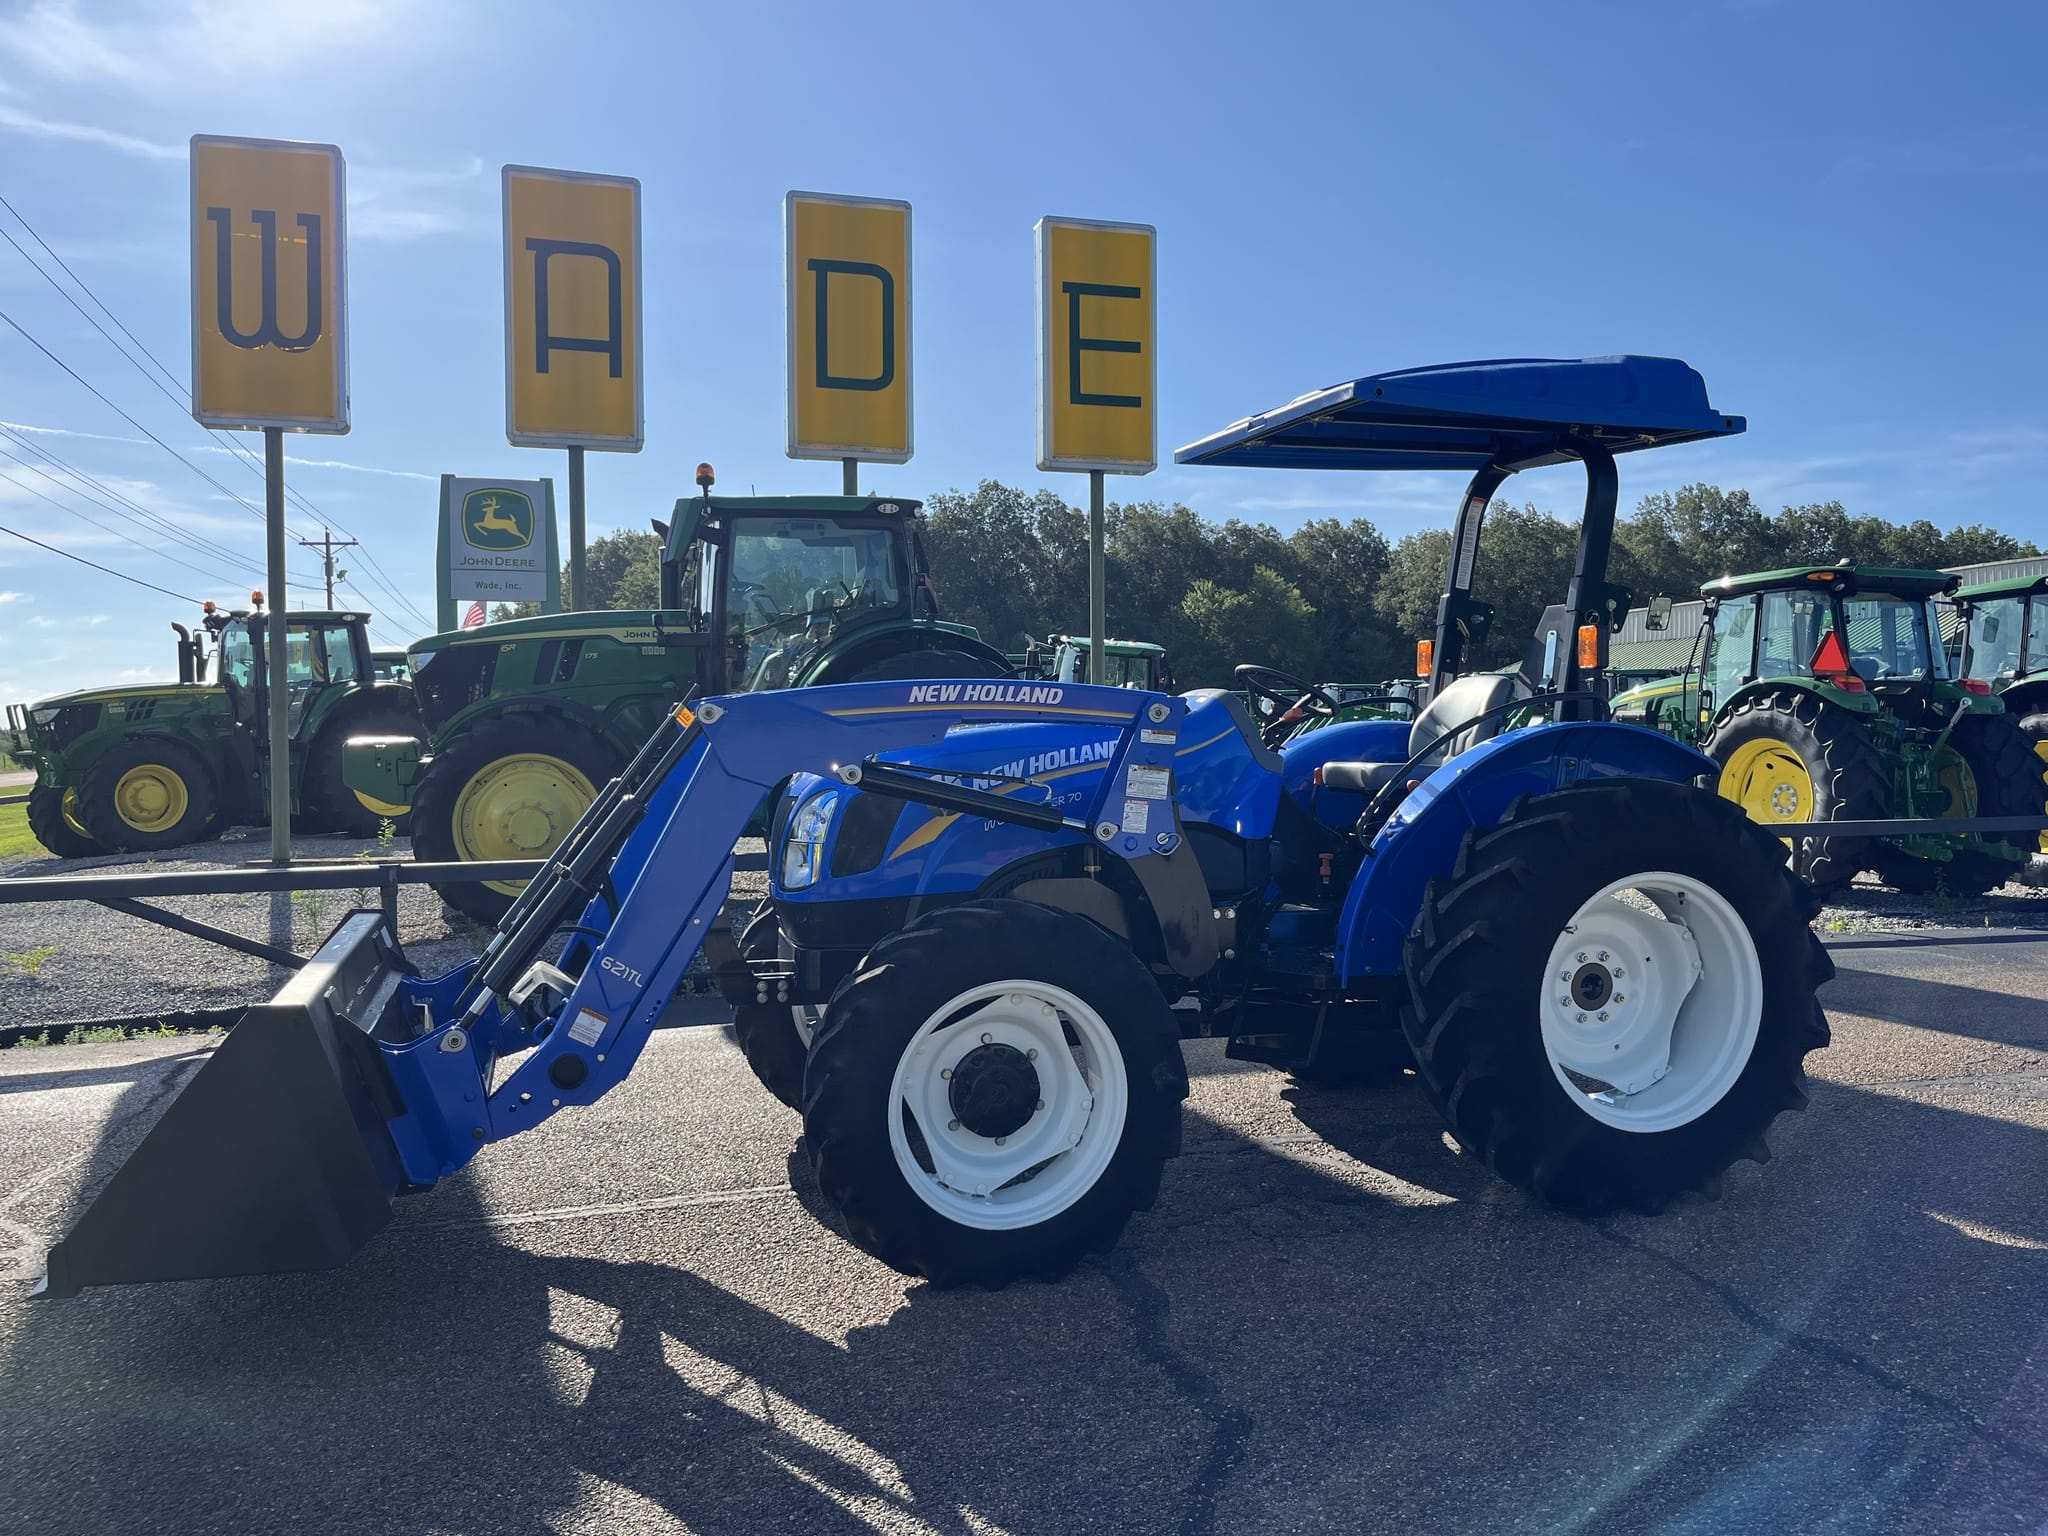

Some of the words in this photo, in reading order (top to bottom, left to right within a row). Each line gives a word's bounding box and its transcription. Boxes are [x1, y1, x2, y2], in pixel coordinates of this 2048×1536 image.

[460, 555, 493, 566] JOHN
[495, 556, 536, 568] DEERE
[475, 581, 502, 590] Wade,
[505, 582, 522, 590] Inc.
[624, 630, 650, 639] JOHN
[501, 643, 517, 652] 6R
[908, 684, 962, 704] NEW
[963, 684, 1064, 705] HOLLAND
[1067, 791, 1082, 803] 70
[601, 956, 643, 988] 621TL
